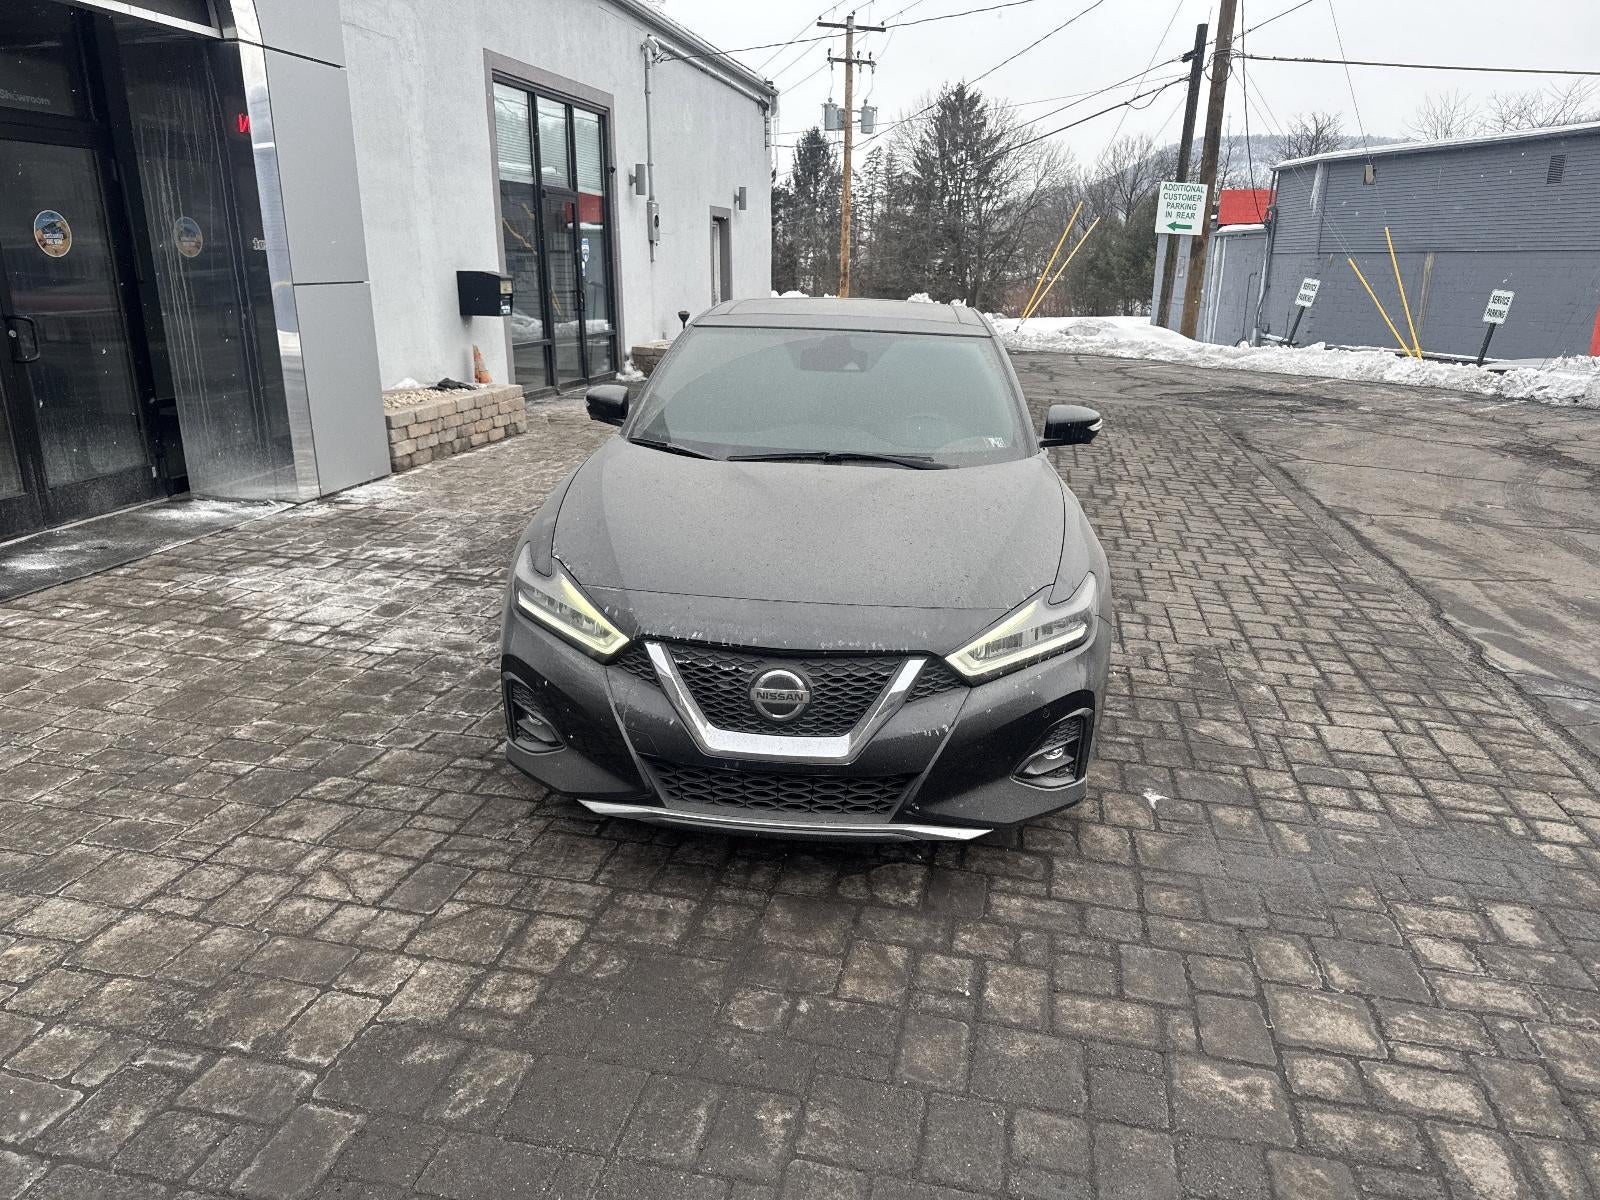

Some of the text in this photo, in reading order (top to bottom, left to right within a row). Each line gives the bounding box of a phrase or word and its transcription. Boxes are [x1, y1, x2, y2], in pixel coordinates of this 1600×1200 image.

[1163, 183, 1204, 193] ADDITIONAL
[1163, 193, 1202, 202] CUSTOMER
[1166, 202, 1197, 211] PARKING
[1165, 210, 1196, 220] IN REAR
[1302, 282, 1318, 292] SERVICE
[1298, 293, 1314, 303] PARKING
[1491, 294, 1511, 305] SERVICE
[1486, 307, 1506, 319] PARKING
[756, 691, 804, 702] NISSAN
